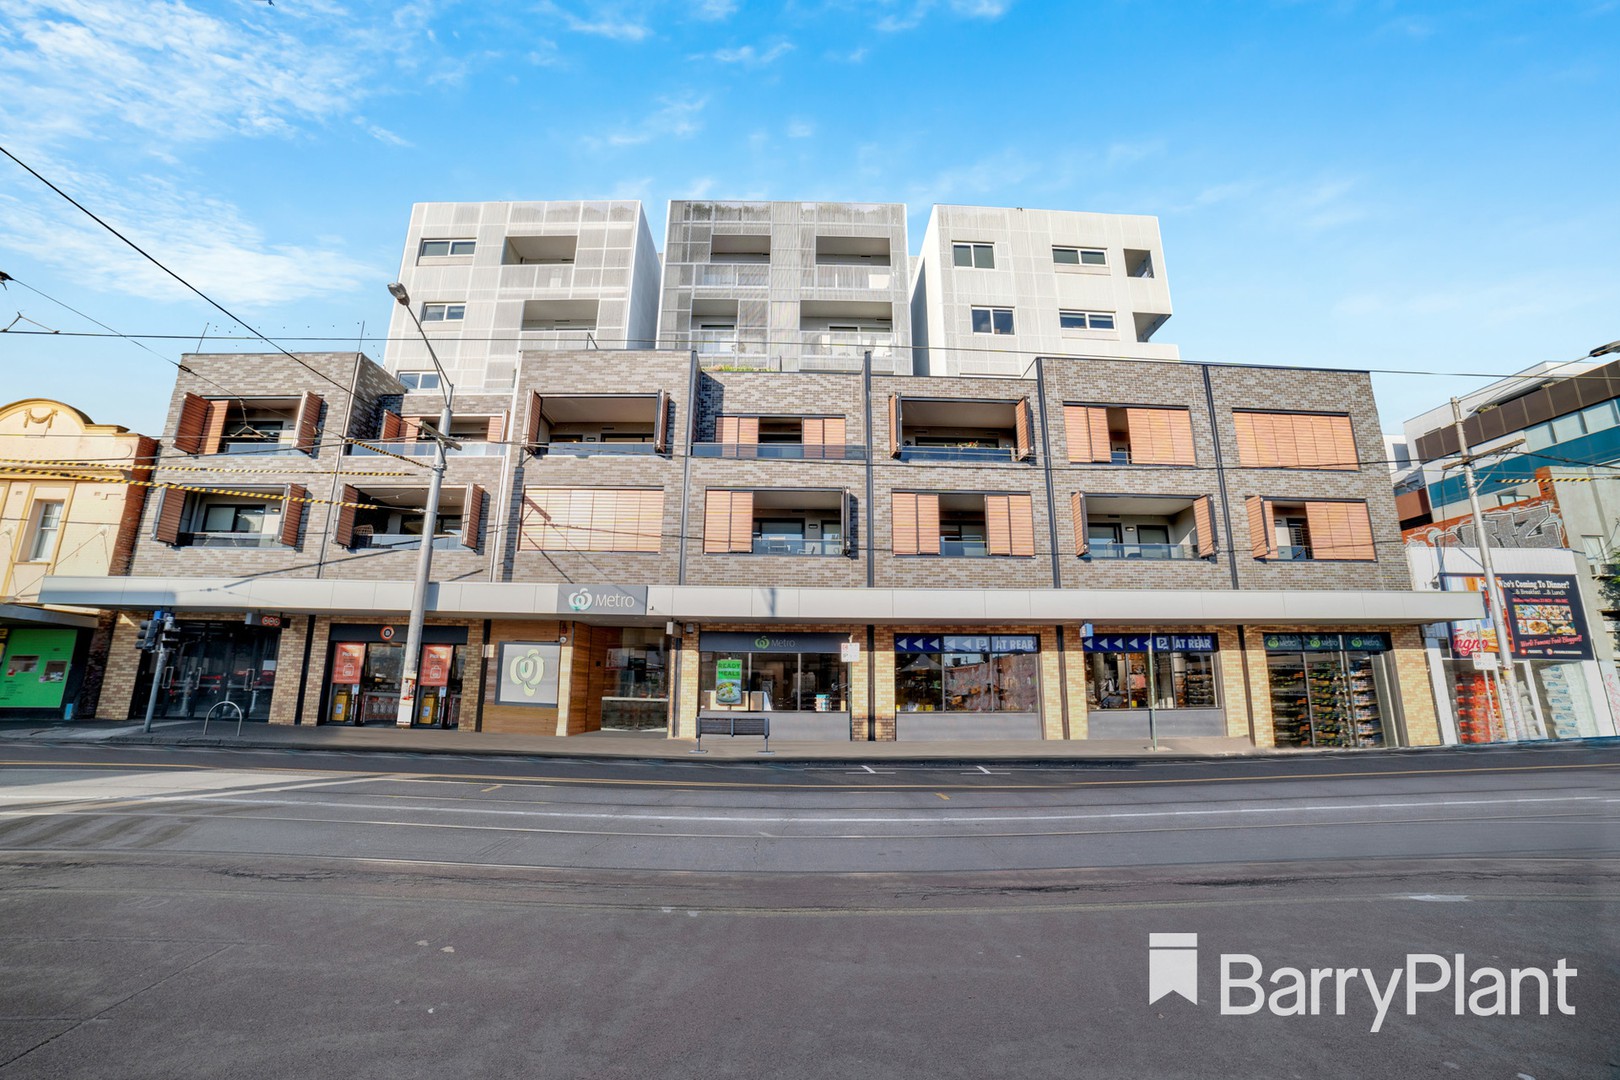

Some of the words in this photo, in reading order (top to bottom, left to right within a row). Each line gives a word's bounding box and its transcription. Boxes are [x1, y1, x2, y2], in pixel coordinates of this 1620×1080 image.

[1515, 580, 1538, 589] Coming
[1538, 580, 1546, 588] To
[1546, 580, 1570, 589] Dinner?
[595, 594, 635, 608] Metro
[771, 638, 796, 648] Metro
[996, 640, 1006, 650] AT
[1010, 639, 1034, 650] REAR
[1175, 639, 1186, 649] AT
[1188, 639, 1211, 649] REAR
